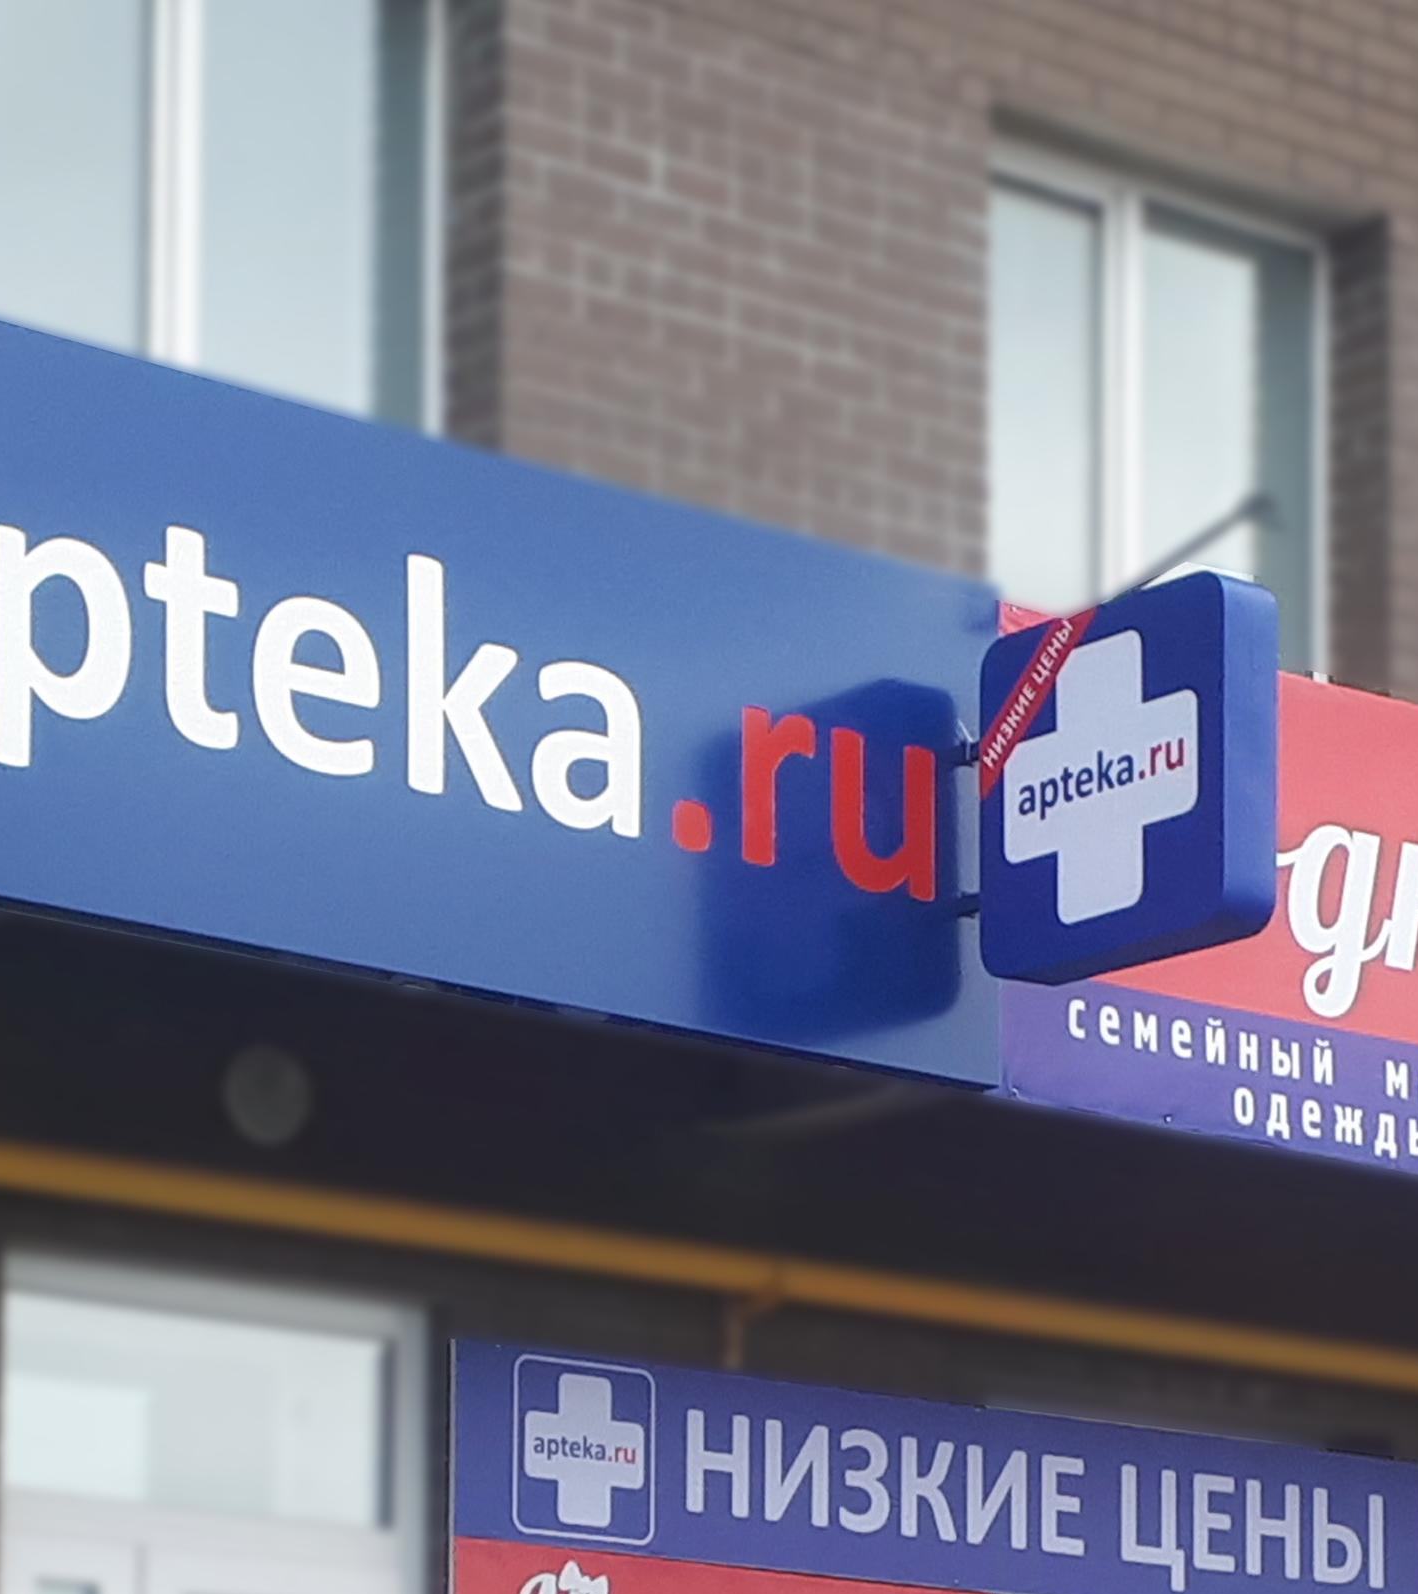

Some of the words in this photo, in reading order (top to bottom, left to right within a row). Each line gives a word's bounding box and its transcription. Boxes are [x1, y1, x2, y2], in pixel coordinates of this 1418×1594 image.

[984, 683, 1036, 769] НИЗКИЕ
[1030, 619, 1074, 684] ЦЕНЫ
[1018, 737, 1185, 820] apteka.ru
[1067, 994, 1335, 1086] семейный
[533, 1435, 636, 1464] apteka.ru
[685, 1408, 1085, 1557] НИЗКИЕ
[1120, 1463, 1386, 1592] ЦЕНЫ
